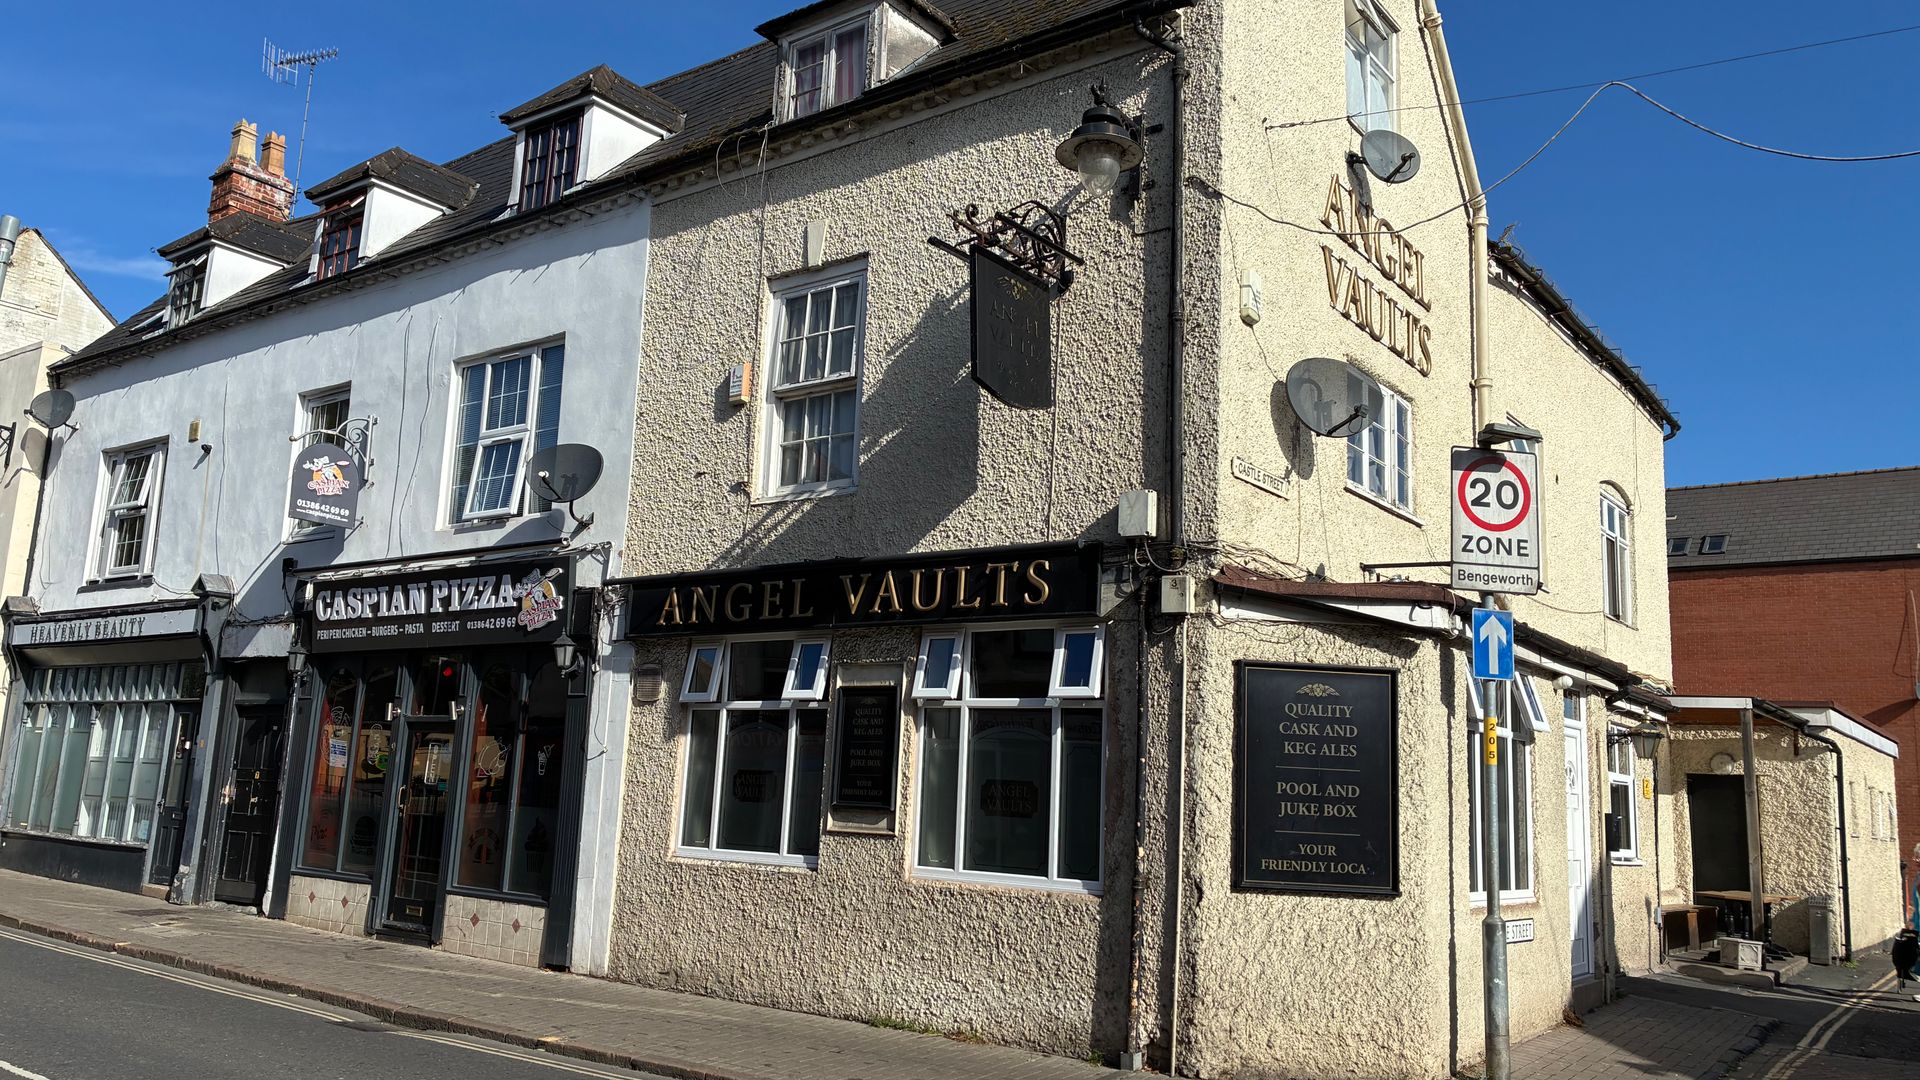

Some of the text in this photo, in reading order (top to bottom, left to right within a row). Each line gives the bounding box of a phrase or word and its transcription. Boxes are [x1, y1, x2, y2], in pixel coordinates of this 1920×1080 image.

[1320, 174, 1431, 312] ANGEL
[1320, 244, 1431, 377] VAULTS
[307, 479, 350, 490] CASPIAN
[1239, 463, 1284, 491] CASTLE STREET
[316, 486, 343, 495] PIZZA
[1469, 477, 1519, 510] 20
[296, 499, 350, 516] 01386 42 69 69
[1461, 535, 1529, 557] ZONE
[1457, 569, 1533, 586] Bengeworth
[315, 574, 517, 622] CASPIAN PIZZA
[656, 559, 1050, 625] ANGEL VAULTS
[518, 597, 561, 625] CASPIAN
[528, 609, 555, 629] PIZZA
[30, 616, 146, 644] HEAVENLY BEAUTY
[341, 626, 367, 639] CHICKEN
[372, 625, 398, 637] BURGERS
[404, 623, 424, 635] PASTA
[431, 621, 460, 634] DESSERT
[466, 619, 486, 630] 01386
[485, 618, 495, 629] 42
[496, 617, 506, 628] 69
[507, 616, 516, 628] 69
[1284, 702, 1353, 718] QUALITY
[1279, 721, 1358, 738] CASK AND
[1283, 741, 1358, 758] KEG ALES
[1488, 723, 1496, 759] 205
[989, 783, 1030, 797] ANGEL
[1276, 781, 1360, 798] POOL AND
[986, 798, 1033, 812] VAULTS
[1278, 801, 1358, 818] JUKE BOX
[1299, 843, 1337, 856] YOUR
[1261, 858, 1328, 873] FRIENDLY
[1511, 923, 1532, 939] STREET
